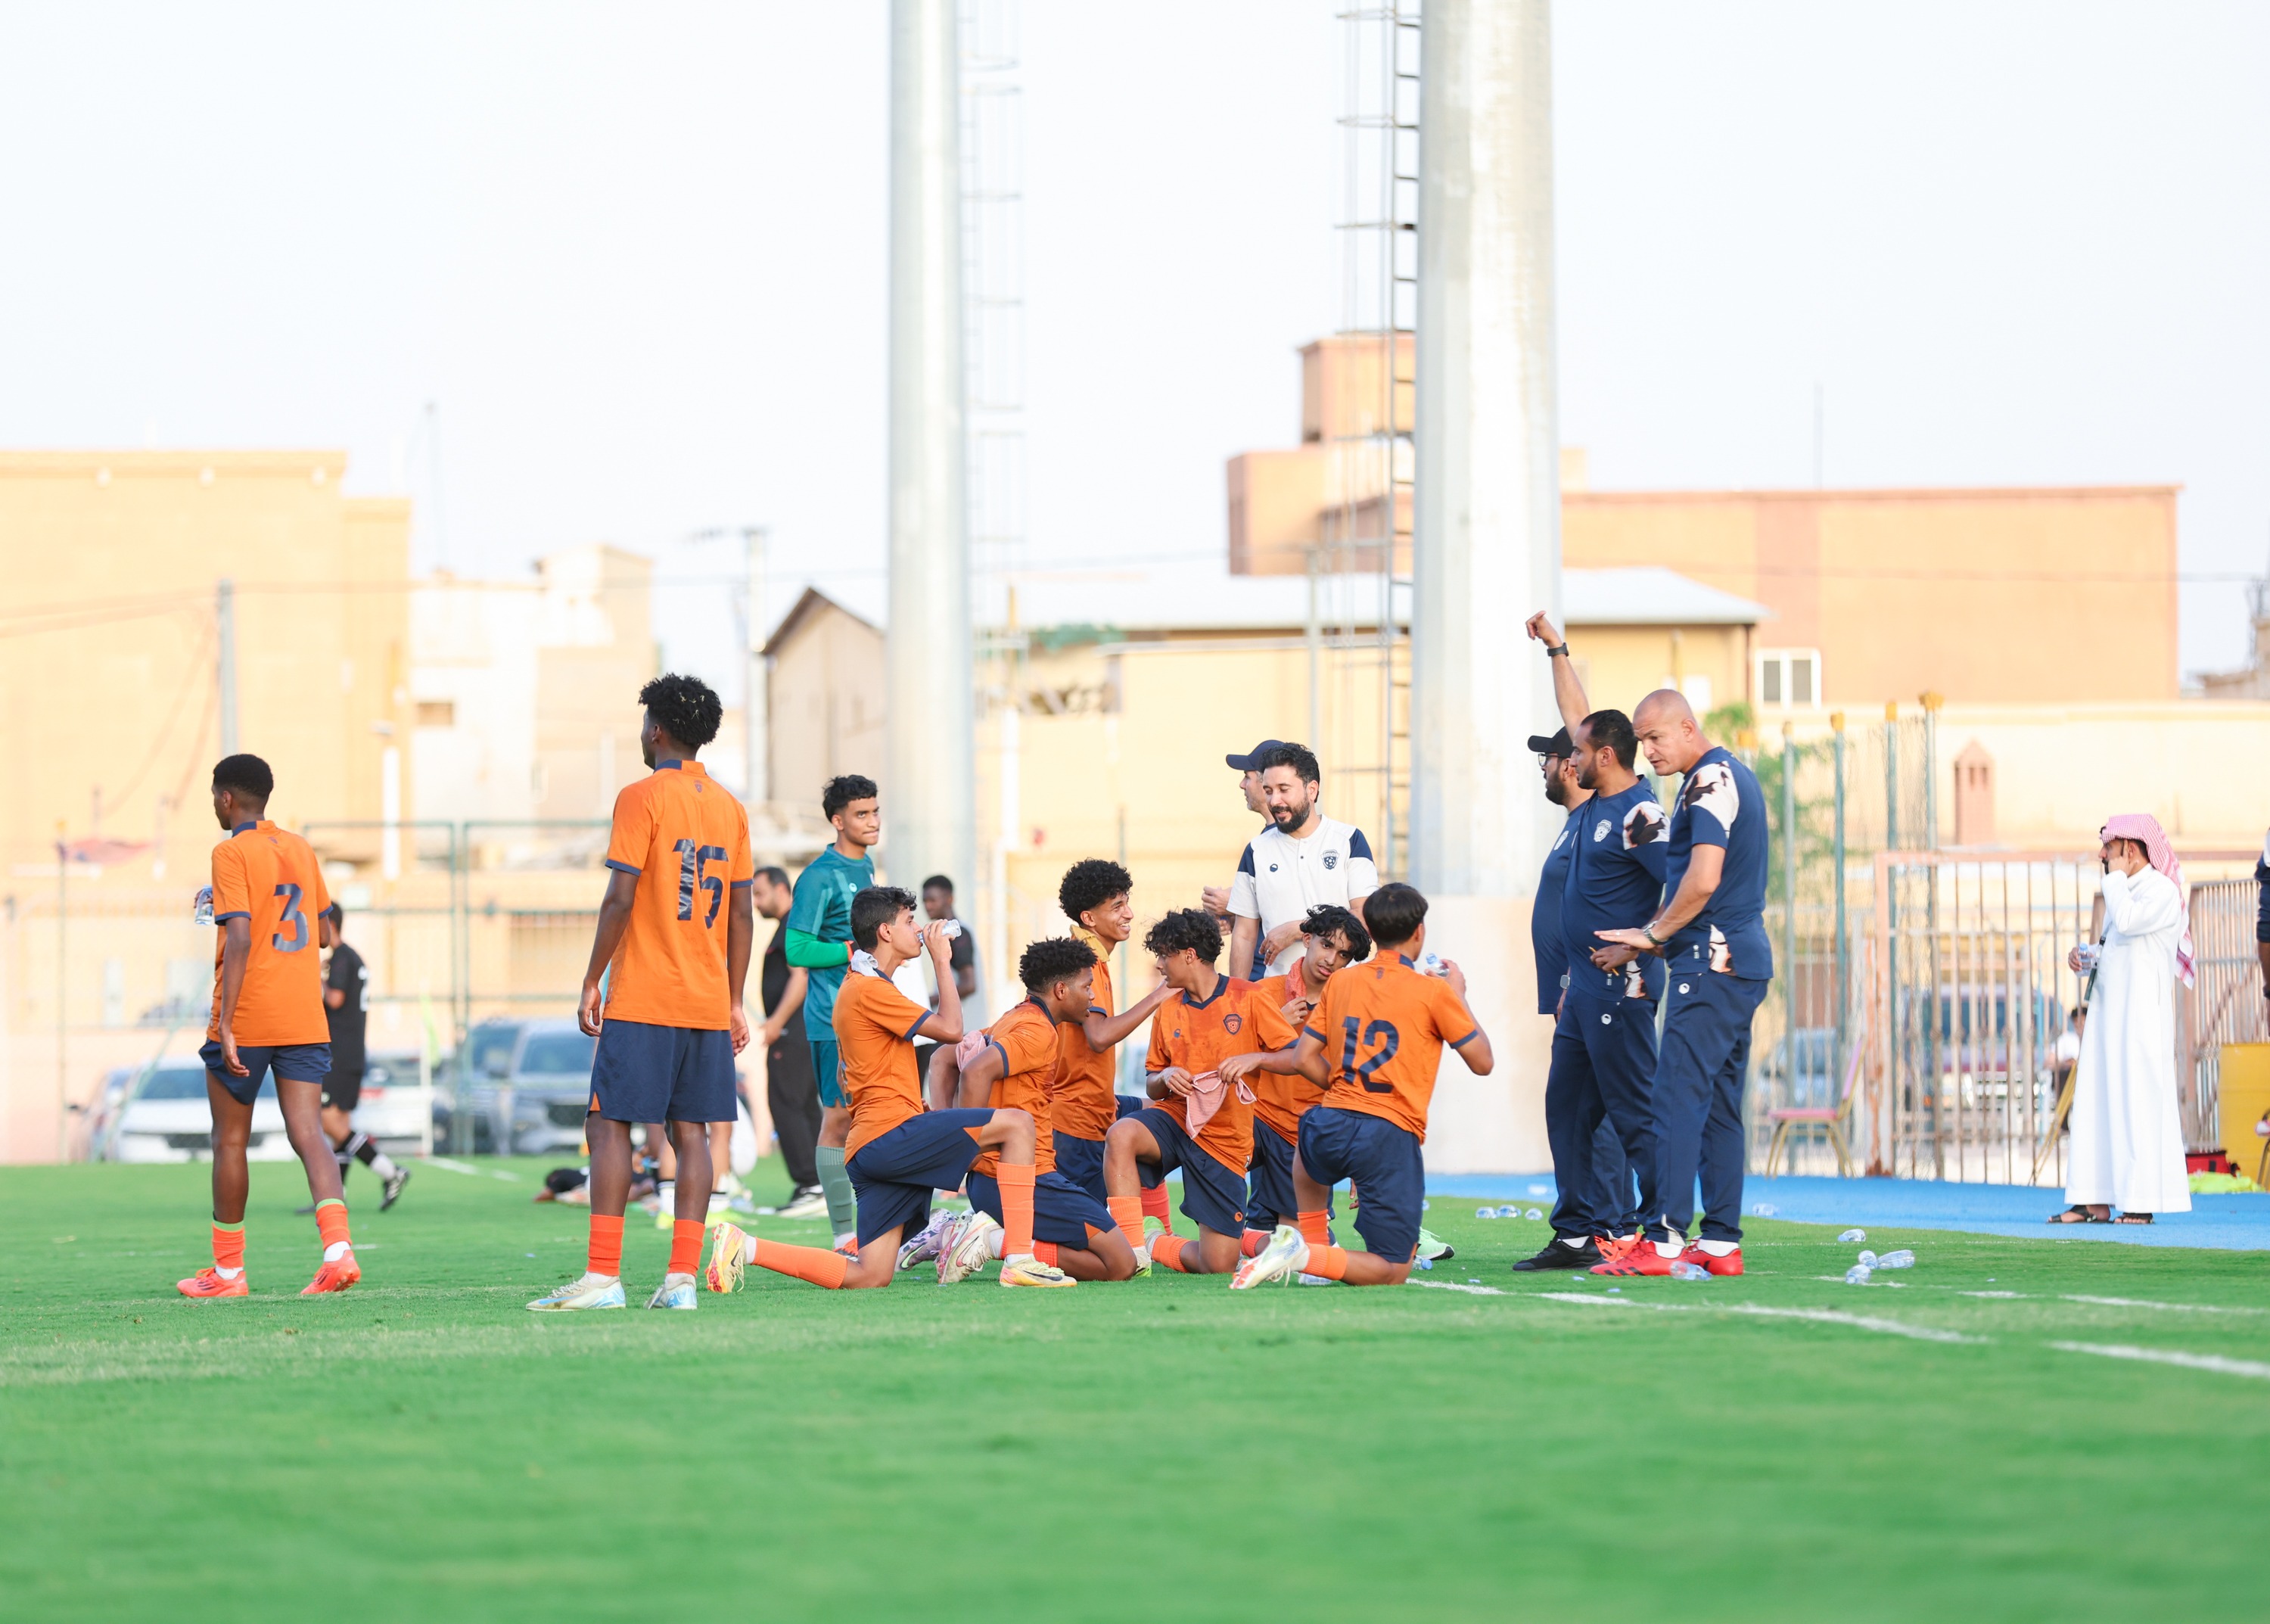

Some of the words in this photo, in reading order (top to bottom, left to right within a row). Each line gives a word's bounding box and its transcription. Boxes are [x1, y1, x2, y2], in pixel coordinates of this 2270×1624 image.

[272, 883, 309, 953] 3
[672, 838, 729, 929] 15
[1342, 1016, 1399, 1094] 12
